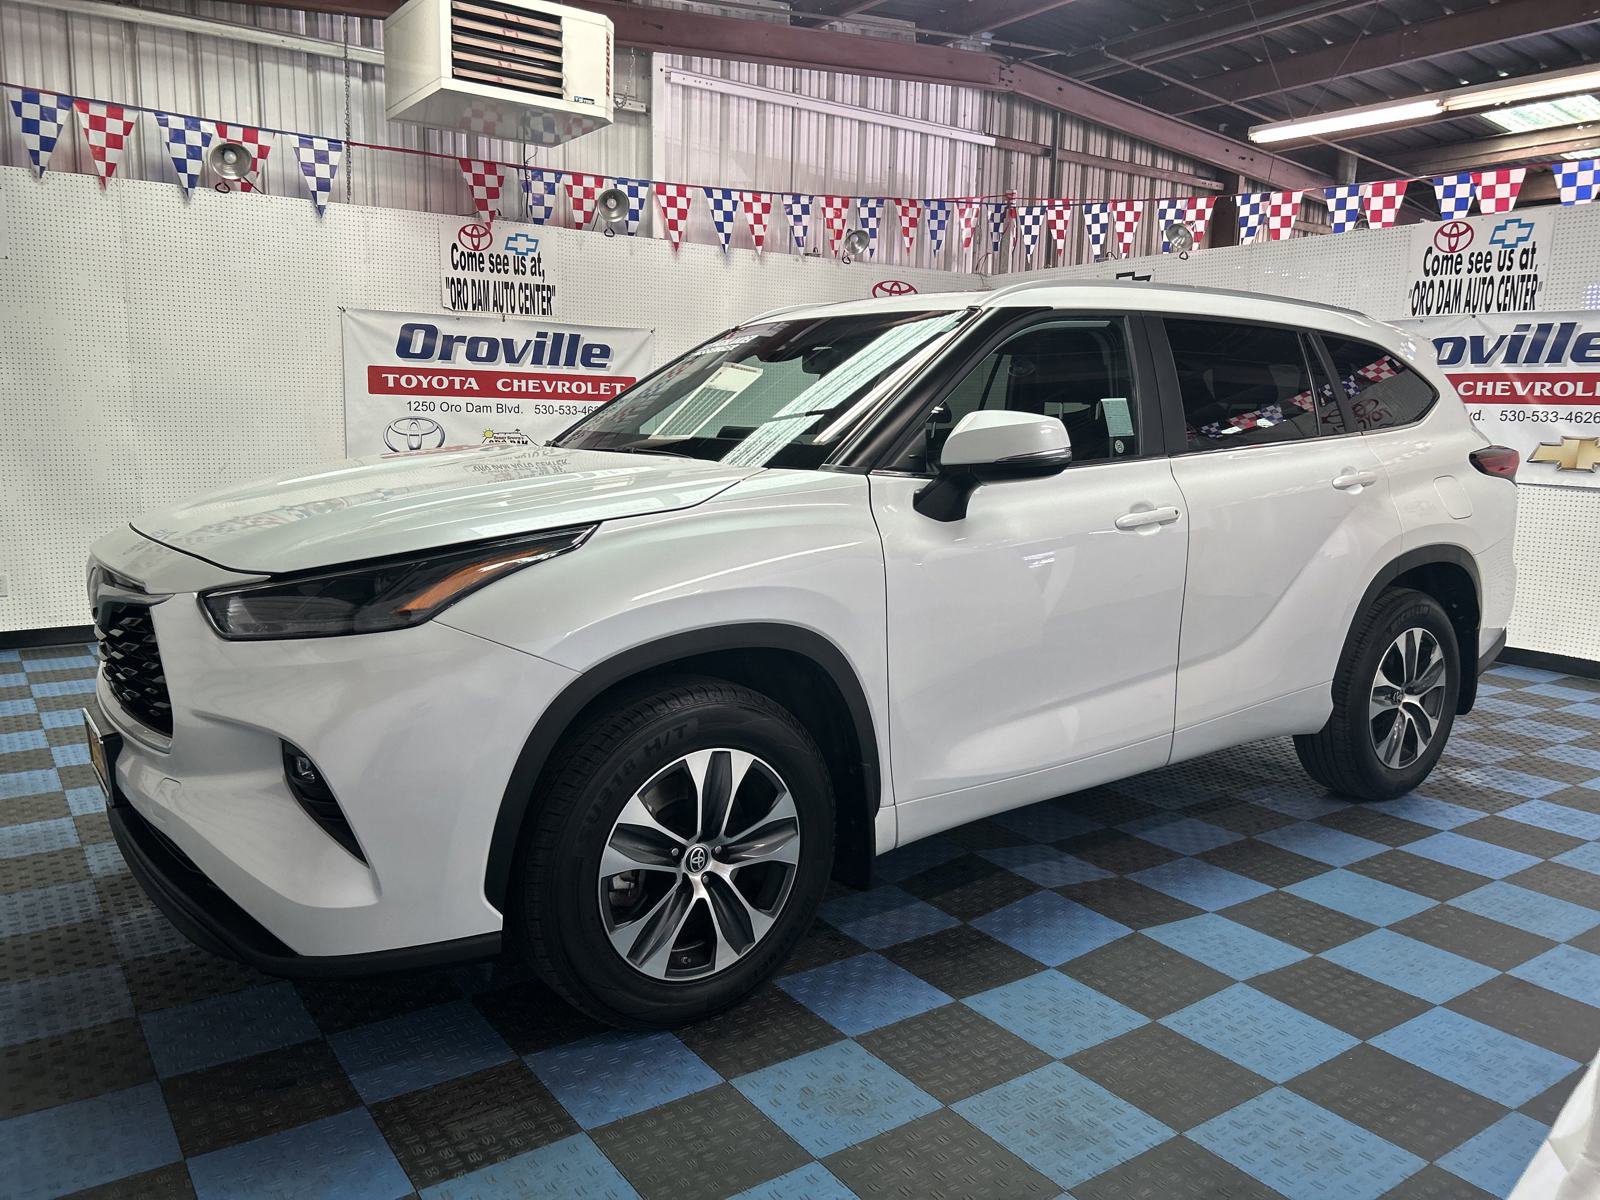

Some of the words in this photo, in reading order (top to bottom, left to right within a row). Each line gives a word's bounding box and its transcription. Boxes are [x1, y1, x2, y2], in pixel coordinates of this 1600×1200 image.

[450, 242, 485, 273] Come
[488, 252, 509, 275] see
[513, 255, 527, 276] us
[530, 251, 545, 283] at,
[1423, 246, 1463, 278] Come
[1466, 250, 1493, 275] see
[1497, 248, 1515, 272] us
[1519, 241, 1538, 273] at,
[445, 276, 469, 311] "ORO
[471, 279, 490, 312] DAM
[492, 280, 516, 314] AUTO
[518, 282, 556, 316] CENTER"
[1408, 279, 1435, 317] "ORO
[1435, 278, 1463, 315] DAM
[1463, 275, 1495, 314] AUTO
[1496, 273, 1543, 313] CENTER"
[395, 322, 613, 369] Oroville
[1431, 321, 1600, 366] oville
[381, 373, 480, 391] TOYOTA
[496, 377, 626, 396] CHEVROLET
[1457, 380, 1600, 397] CHEVROL
[406, 401, 436, 412] 1250
[439, 401, 462, 414] Oro
[466, 402, 492, 414] Dam
[496, 403, 524, 415] Blvd.
[534, 404, 599, 416] 530-533-46
[1499, 410, 1600, 424] 530-533-4626
